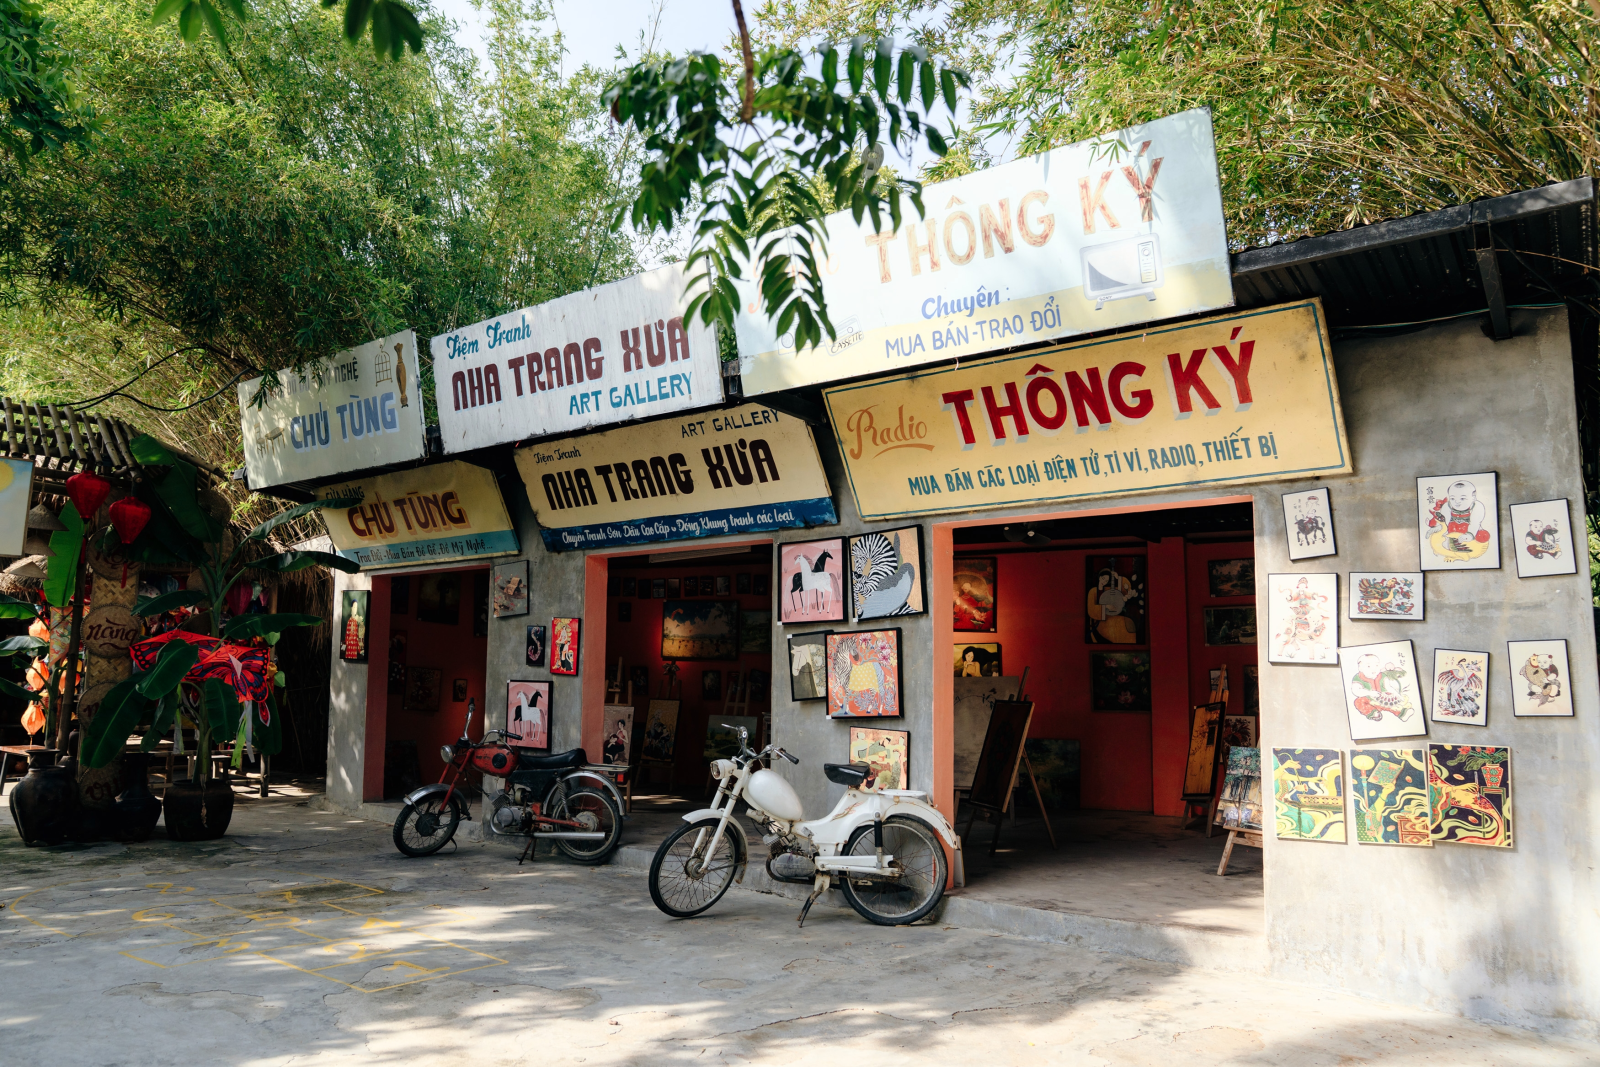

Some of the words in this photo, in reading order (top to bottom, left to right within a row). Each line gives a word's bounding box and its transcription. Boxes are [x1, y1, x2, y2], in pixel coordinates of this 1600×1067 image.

[865, 189, 1055, 284] THÔNG
[1078, 140, 1164, 236] KÝ
[446, 335, 479, 361] Tiệm
[486, 314, 531, 349] Tranh
[831, 331, 863, 353] CASSETTE
[885, 334, 926, 358] MUA
[1030, 295, 1062, 332] ĐỔI
[452, 363, 502, 411] NHA
[508, 337, 604, 397] TRANG
[620, 316, 691, 373] XƯA
[940, 361, 1156, 447] THÔNG
[1167, 326, 1256, 416] KÝ
[569, 390, 602, 415] ART
[609, 372, 692, 408] GALLERY
[290, 402, 330, 451] CHÚ
[336, 391, 398, 440] TÙNG
[681, 421, 705, 438] ART
[712, 409, 779, 432] GALLERY
[847, 404, 928, 461] Radio
[541, 468, 598, 511] NHA
[594, 452, 695, 503] TRANG
[701, 438, 780, 489] XƯA
[554, 446, 581, 460] Tranh
[907, 475, 942, 496] MUA
[1008, 460, 1040, 486] LOẠI
[1043, 454, 1078, 483] ĐIỆN
[1258, 431, 1278, 460] BỊ
[347, 492, 397, 538] CHÚ
[584, 528, 606, 541] Tranh
[640, 524, 654, 536] Cao
[699, 517, 729, 532] Khung
[729, 511, 754, 527] tranh
[756, 509, 773, 524] các
[451, 541, 464, 555] Mỹ
[132, 909, 175, 922] 6
[361, 917, 404, 929] 4
[382, 960, 451, 978] 1
